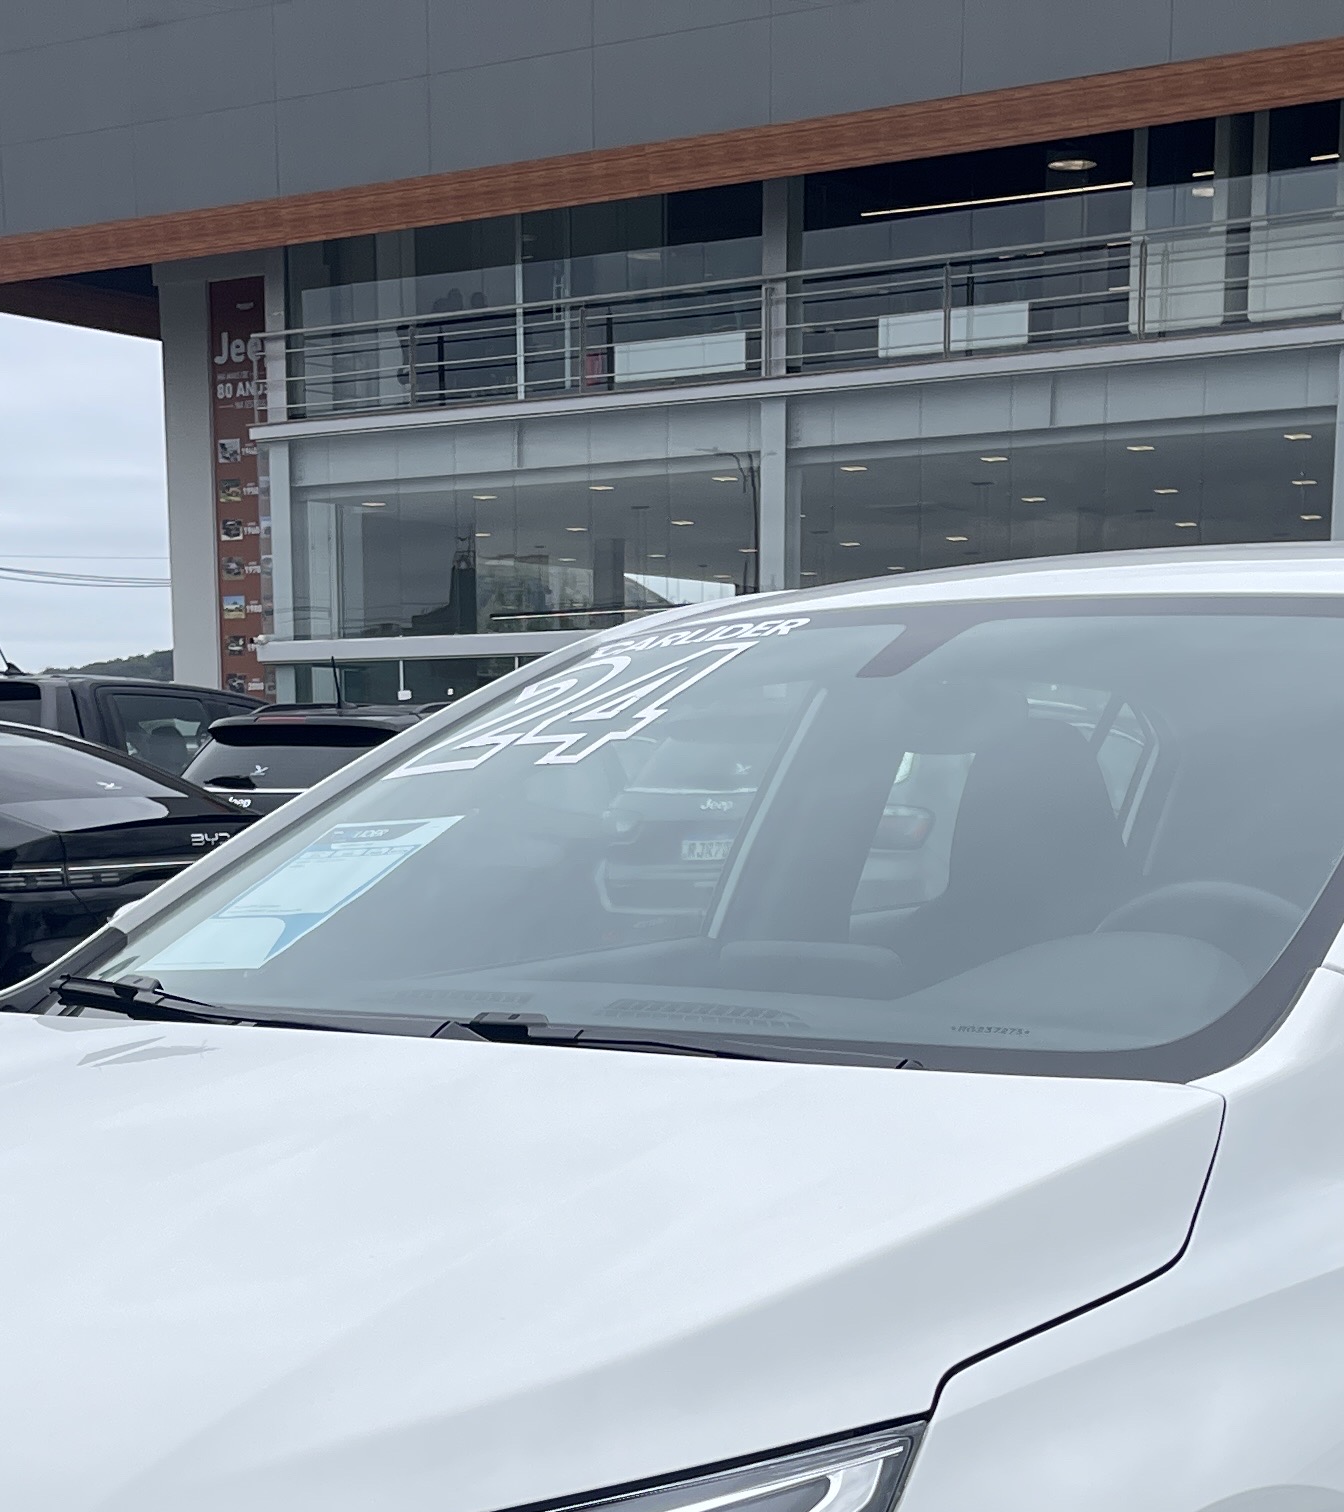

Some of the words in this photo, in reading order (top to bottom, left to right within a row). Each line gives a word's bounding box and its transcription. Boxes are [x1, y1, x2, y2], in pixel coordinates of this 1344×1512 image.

[214, 331, 265, 365] Jee
[217, 383, 233, 399] 80
[591, 618, 811, 659] CARLIDER
